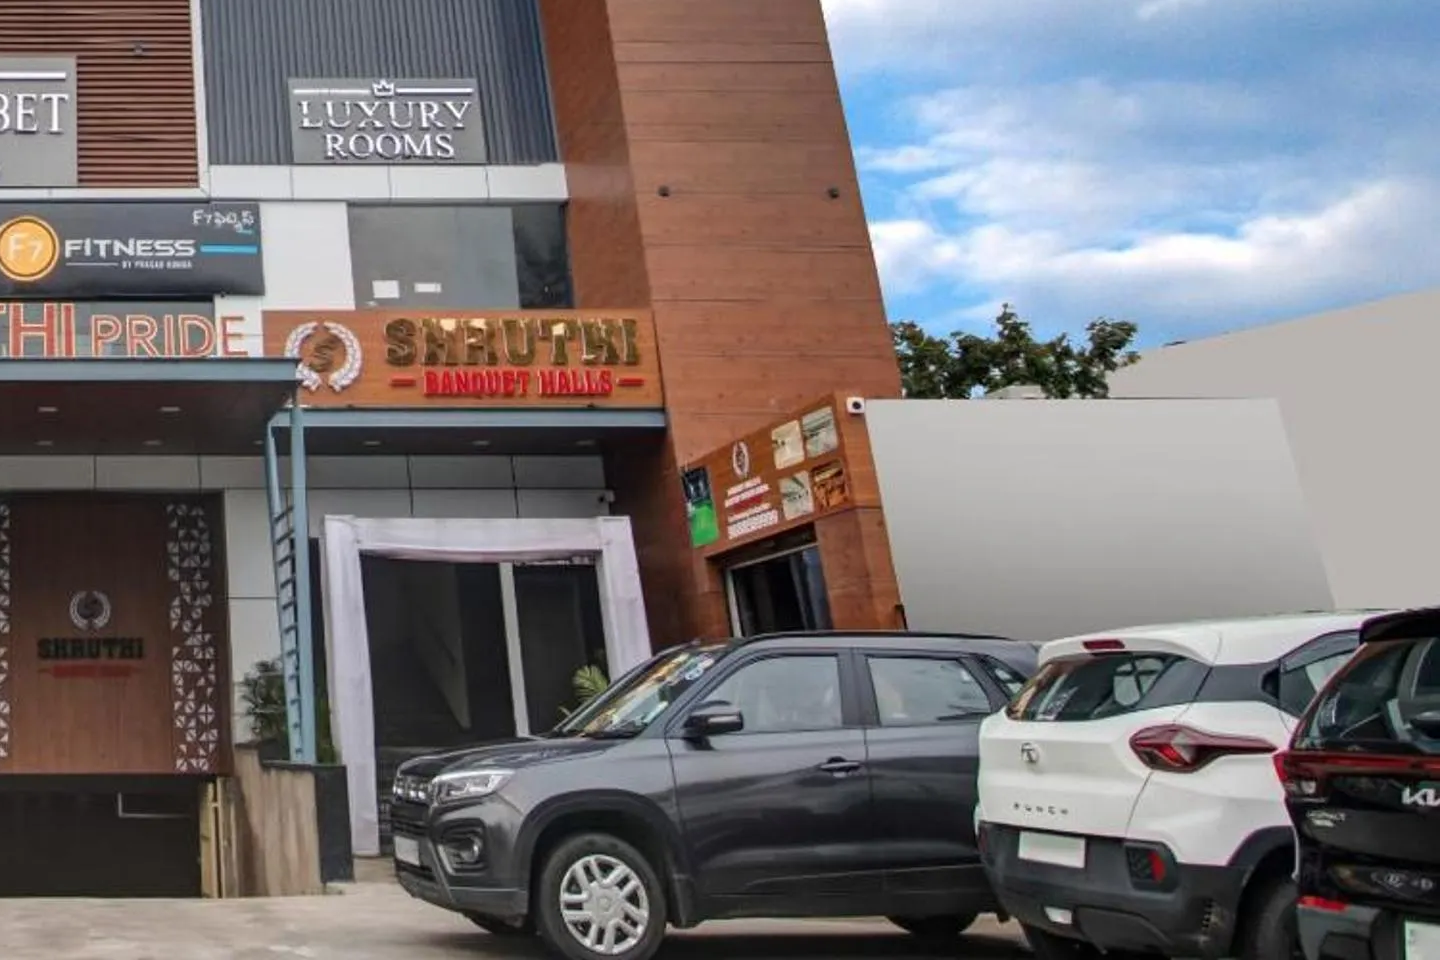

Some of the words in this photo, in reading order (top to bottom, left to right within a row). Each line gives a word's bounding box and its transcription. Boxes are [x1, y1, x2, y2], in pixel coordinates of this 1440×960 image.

[298, 100, 472, 129] LUXURY
[324, 133, 456, 159] ROOMS
[7, 233, 45, 264] F7
[64, 237, 197, 259] FITNESS
[90, 314, 251, 358] PRIDE
[383, 316, 642, 367] SHRUTHI
[424, 369, 530, 398] BANQUET
[536, 369, 614, 397] HALLS
